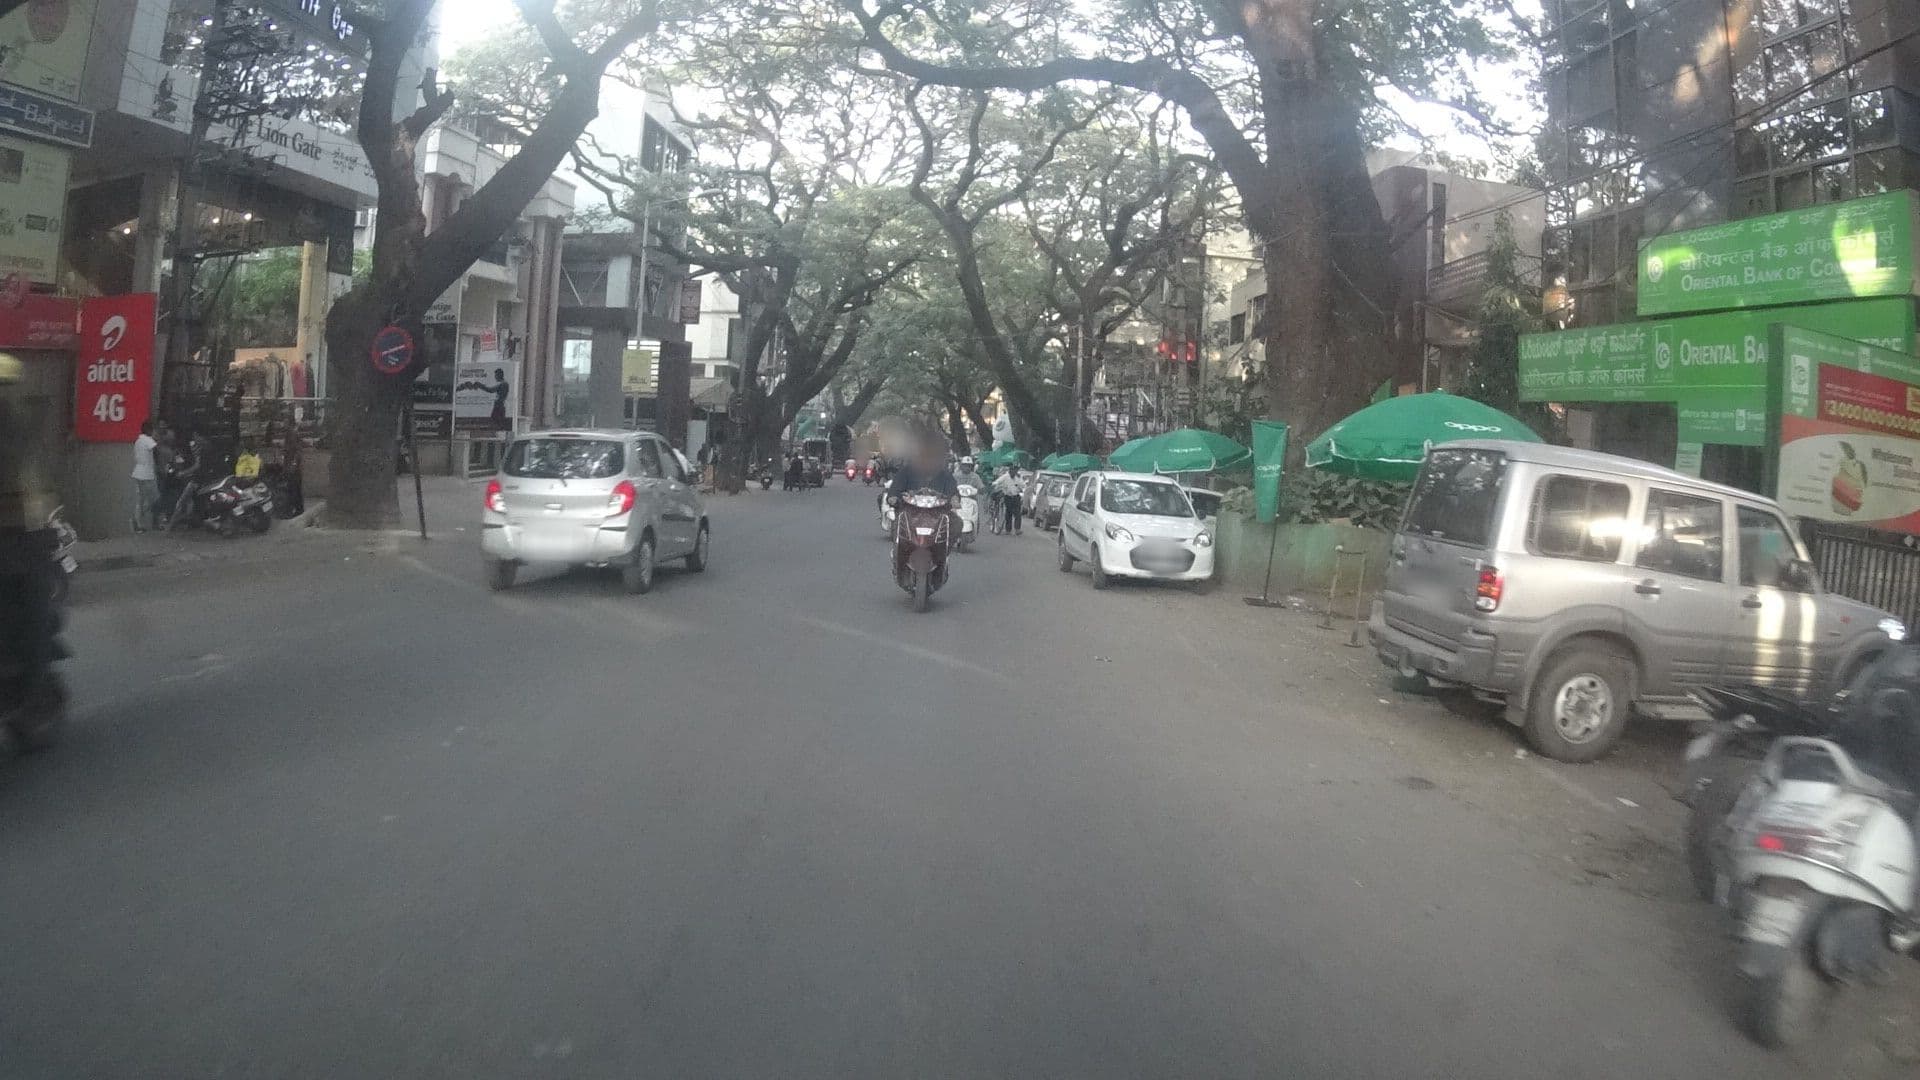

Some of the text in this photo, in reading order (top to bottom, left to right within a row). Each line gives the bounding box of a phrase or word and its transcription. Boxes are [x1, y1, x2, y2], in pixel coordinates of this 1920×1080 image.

[257, 112, 288, 148] Lion
[291, 132, 323, 161] Gate
[1681, 273, 1741, 291] ORIENTAL
[1743, 266, 1783, 285] BANK
[1680, 339, 1740, 366] ORIENTAL
[87, 359, 134, 382] airtel
[93, 394, 126, 422] 4G
